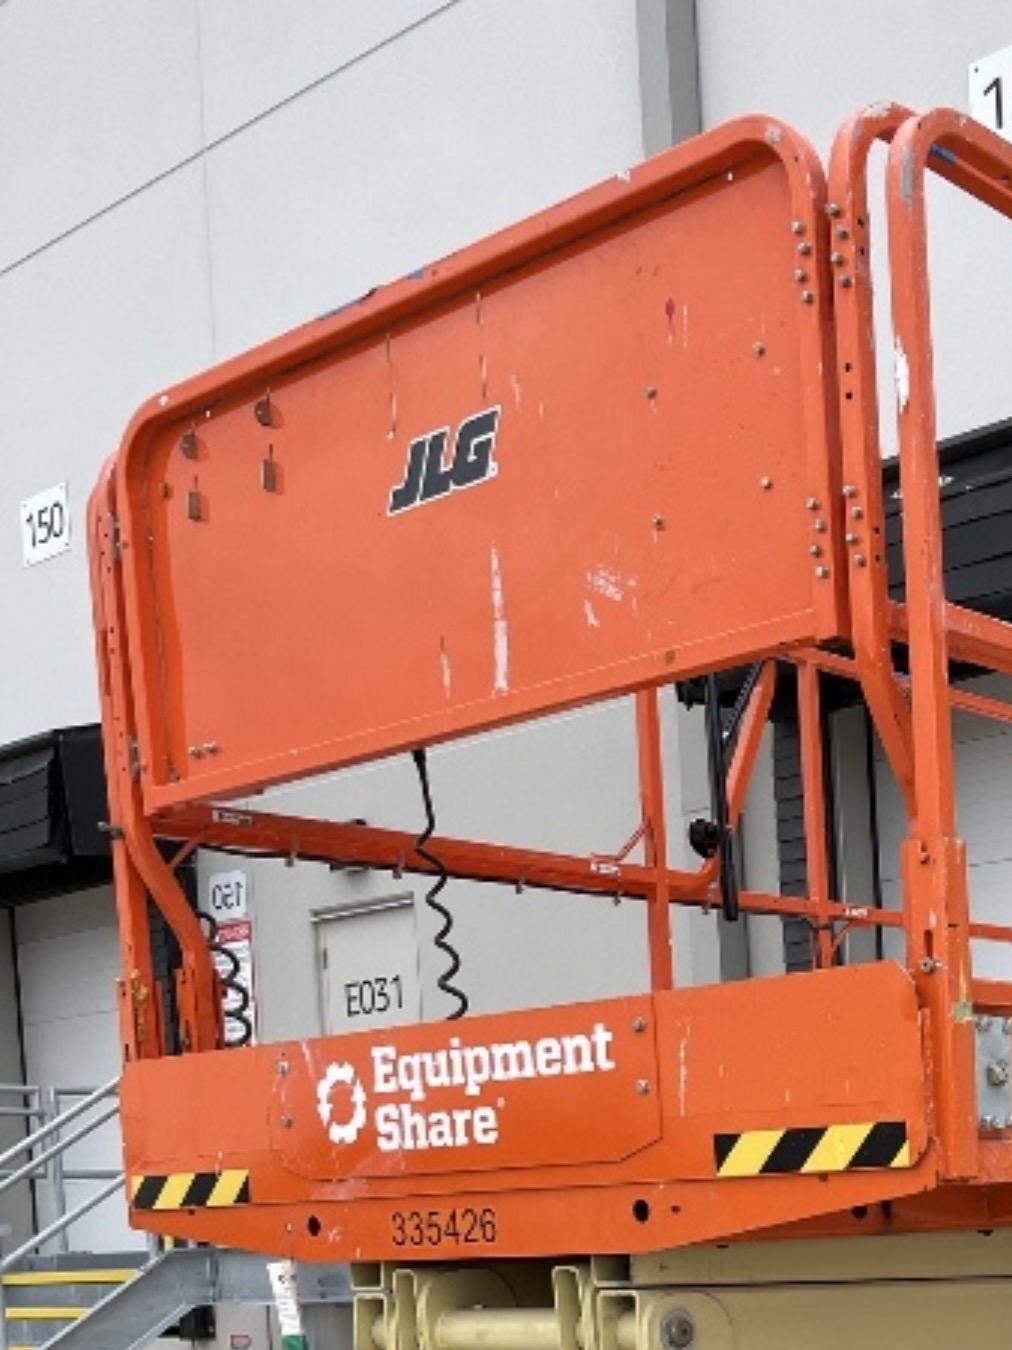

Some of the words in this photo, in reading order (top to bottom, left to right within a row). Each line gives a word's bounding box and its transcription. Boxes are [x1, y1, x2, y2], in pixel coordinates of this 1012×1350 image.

[387, 404, 501, 517] JLG
[25, 500, 63, 549] 150
[344, 974, 403, 1018] E031
[371, 1022, 616, 1102] Equipment
[375, 1103, 499, 1152] Share
[391, 1207, 497, 1247] 335426
